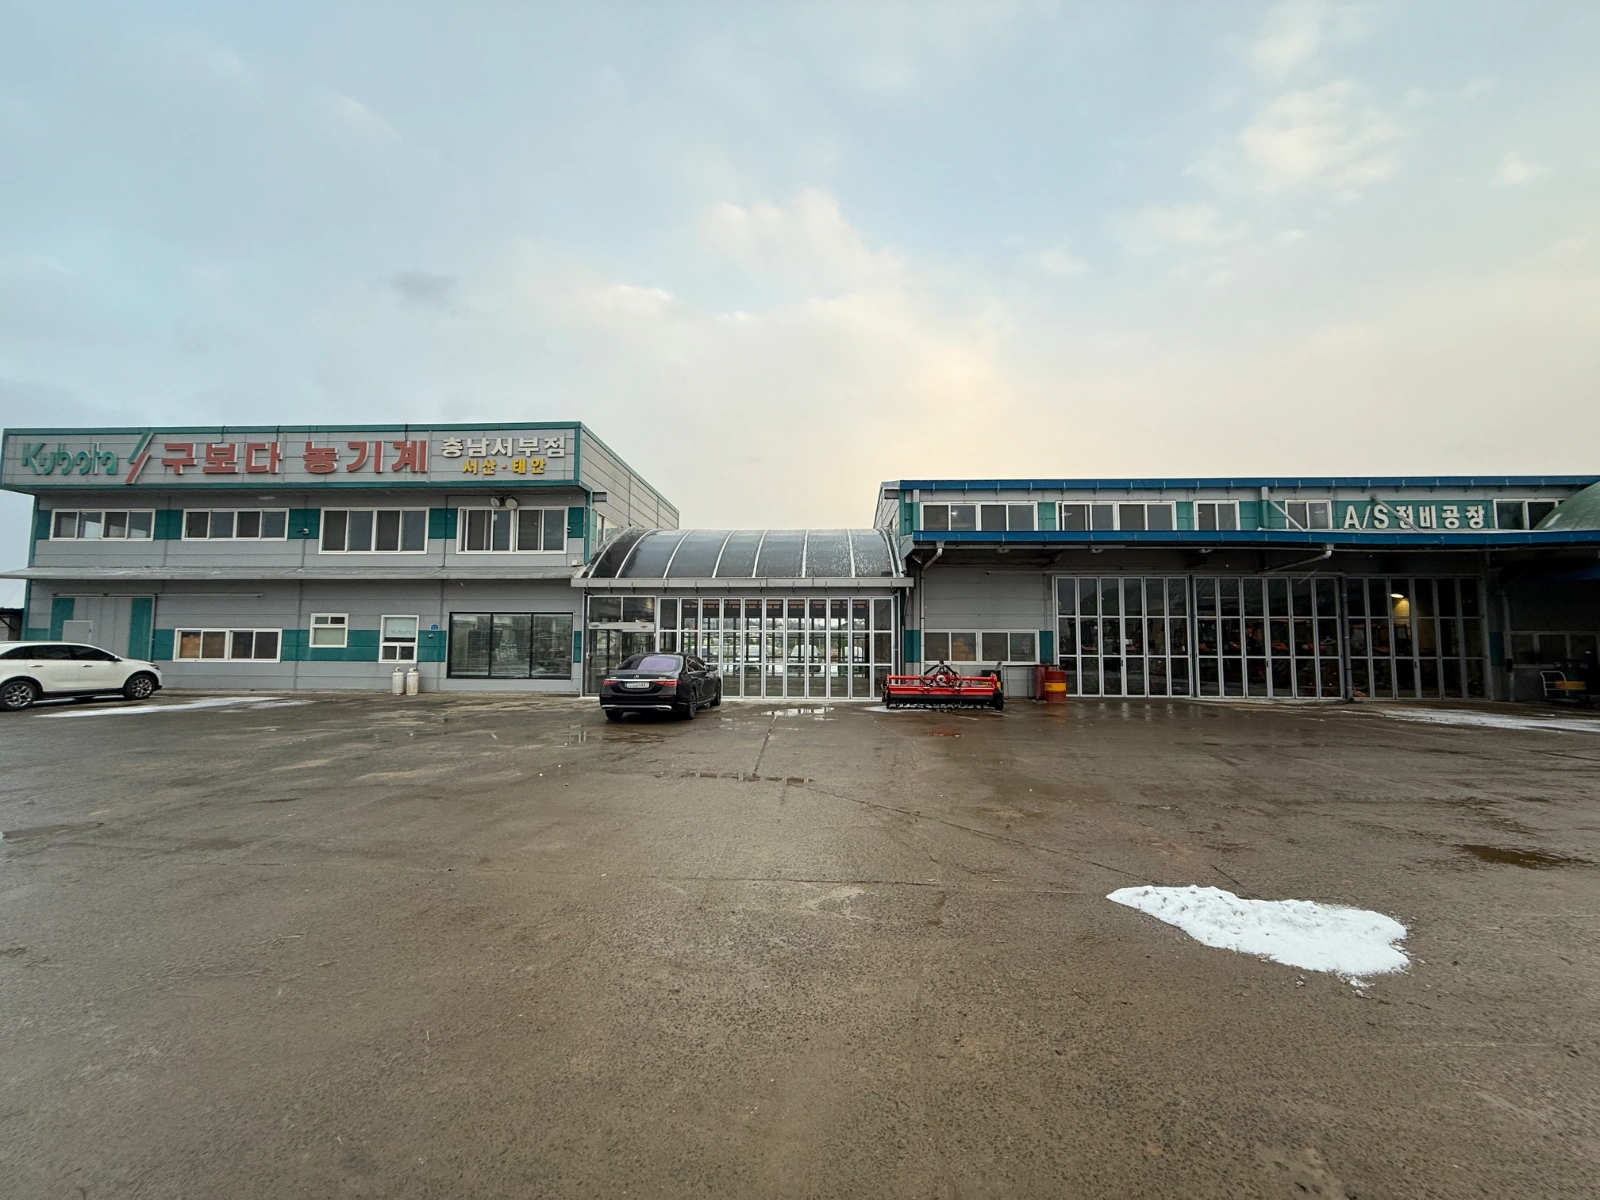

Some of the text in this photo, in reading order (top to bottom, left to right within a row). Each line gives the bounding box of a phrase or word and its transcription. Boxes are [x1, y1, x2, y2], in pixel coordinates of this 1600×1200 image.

[21, 442, 117, 475] Kubota
[161, 440, 429, 475] 구보다 농기계
[441, 436, 566, 458] 충남서부점
